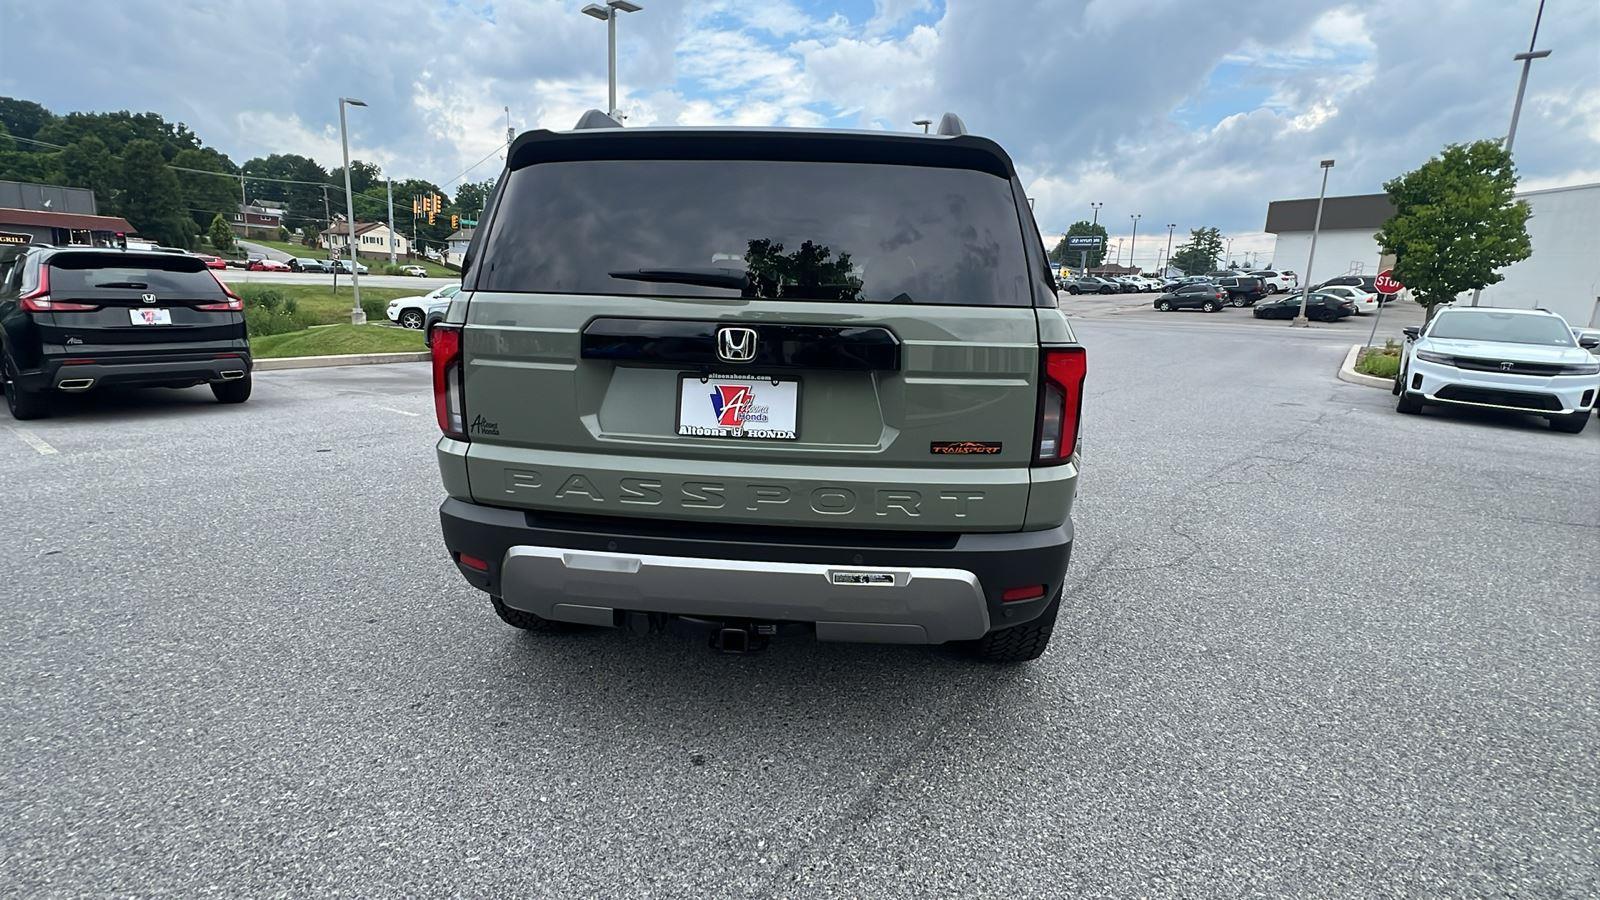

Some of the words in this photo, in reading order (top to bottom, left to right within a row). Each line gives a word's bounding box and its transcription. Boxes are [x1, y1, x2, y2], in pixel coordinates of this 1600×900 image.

[1376, 276, 1401, 288] STO
[708, 373, 772, 381] altoonahonda.com
[737, 412, 769, 422] Honda
[678, 425, 727, 437] Altoona
[747, 429, 796, 439] HONDA
[932, 446, 1001, 454] TRAILSPORT
[504, 467, 986, 518] PASSPORT
